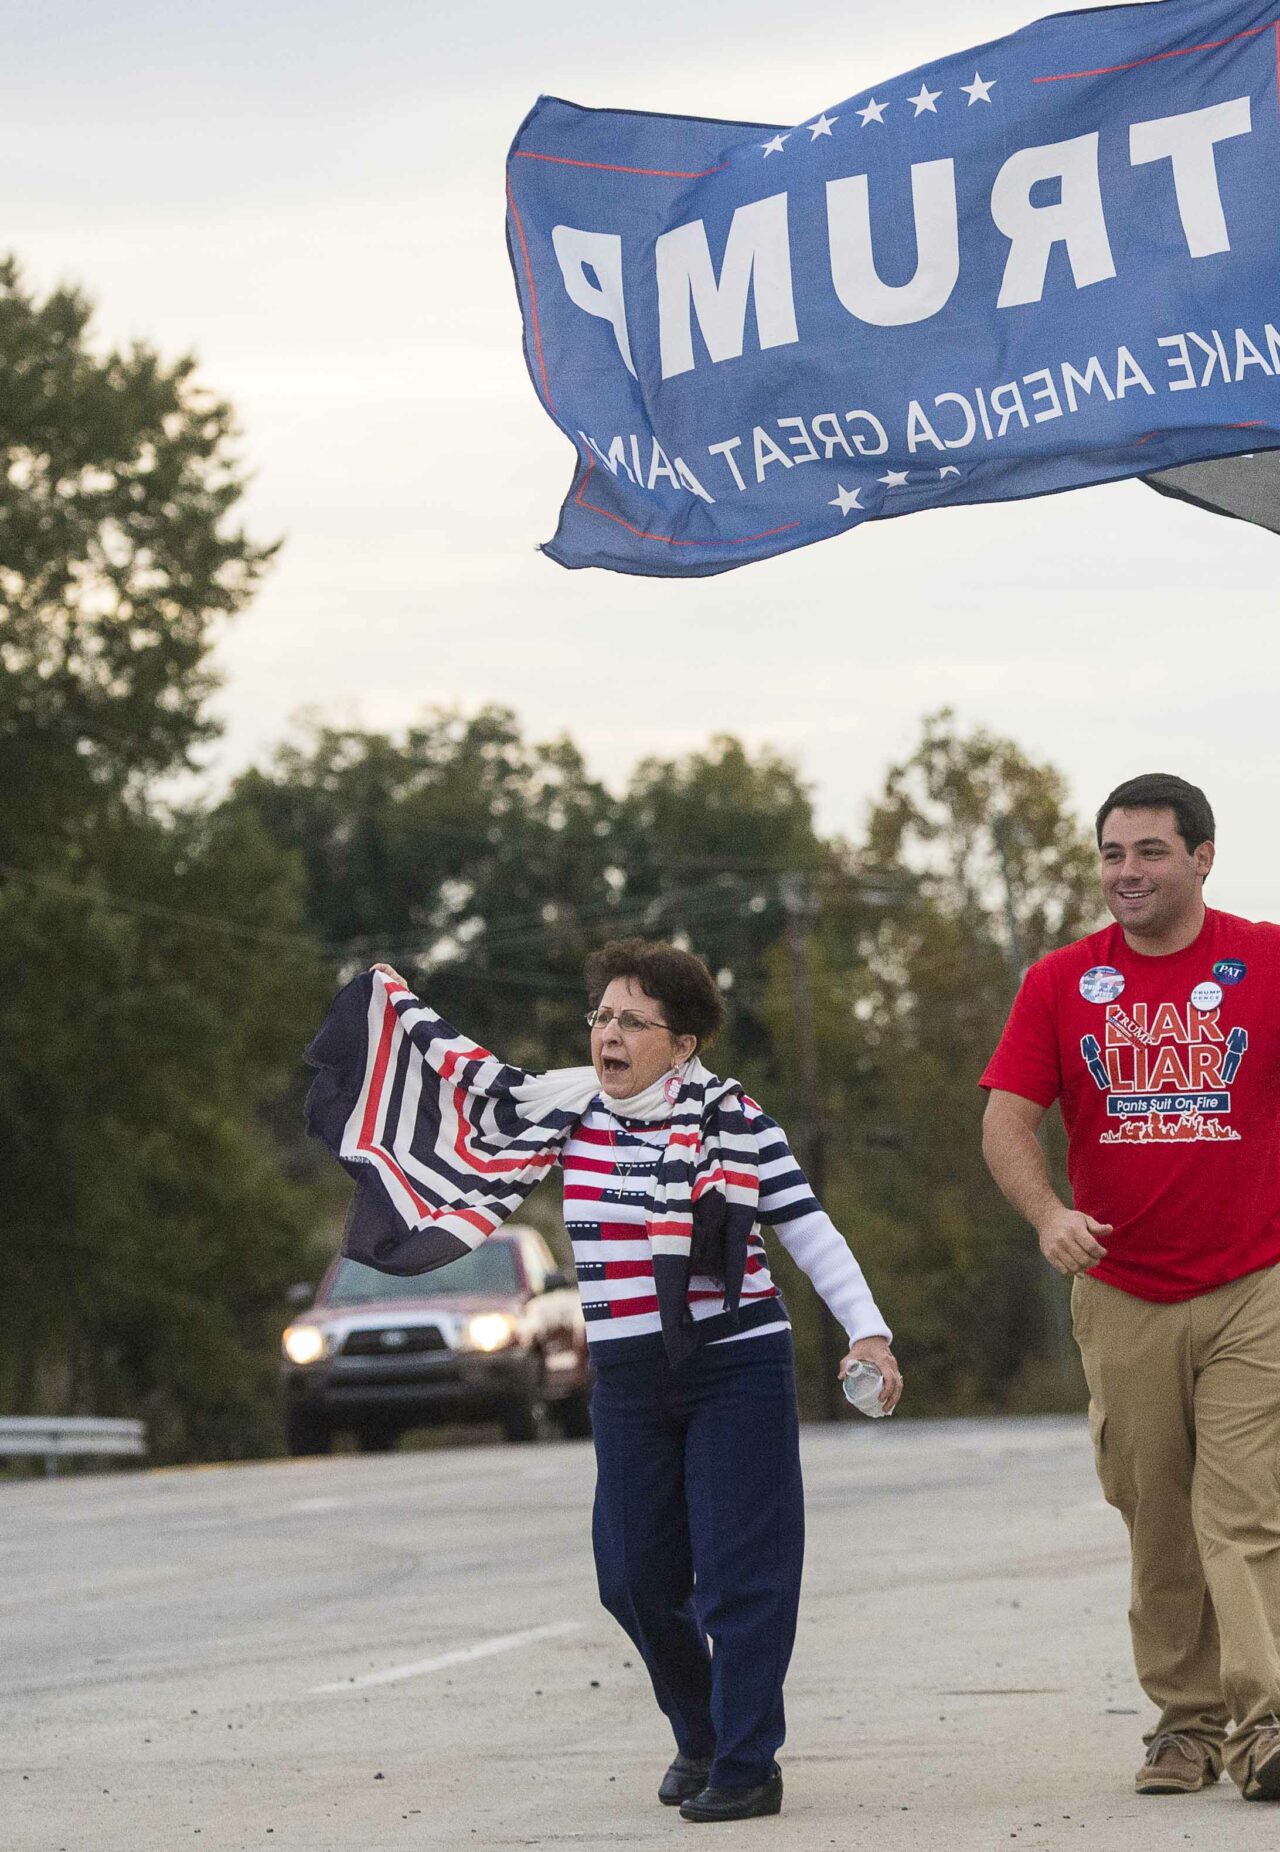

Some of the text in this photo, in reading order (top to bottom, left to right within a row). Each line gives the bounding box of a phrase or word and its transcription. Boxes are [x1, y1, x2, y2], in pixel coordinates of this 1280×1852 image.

[1218, 965, 1243, 978] PAT
[1105, 1002, 1225, 1047] LIAR
[1113, 1008, 1154, 1046] TRUMP
[1106, 1044, 1226, 1093] LIAR
[1117, 1096, 1219, 1112] Pants Suit On Fire
